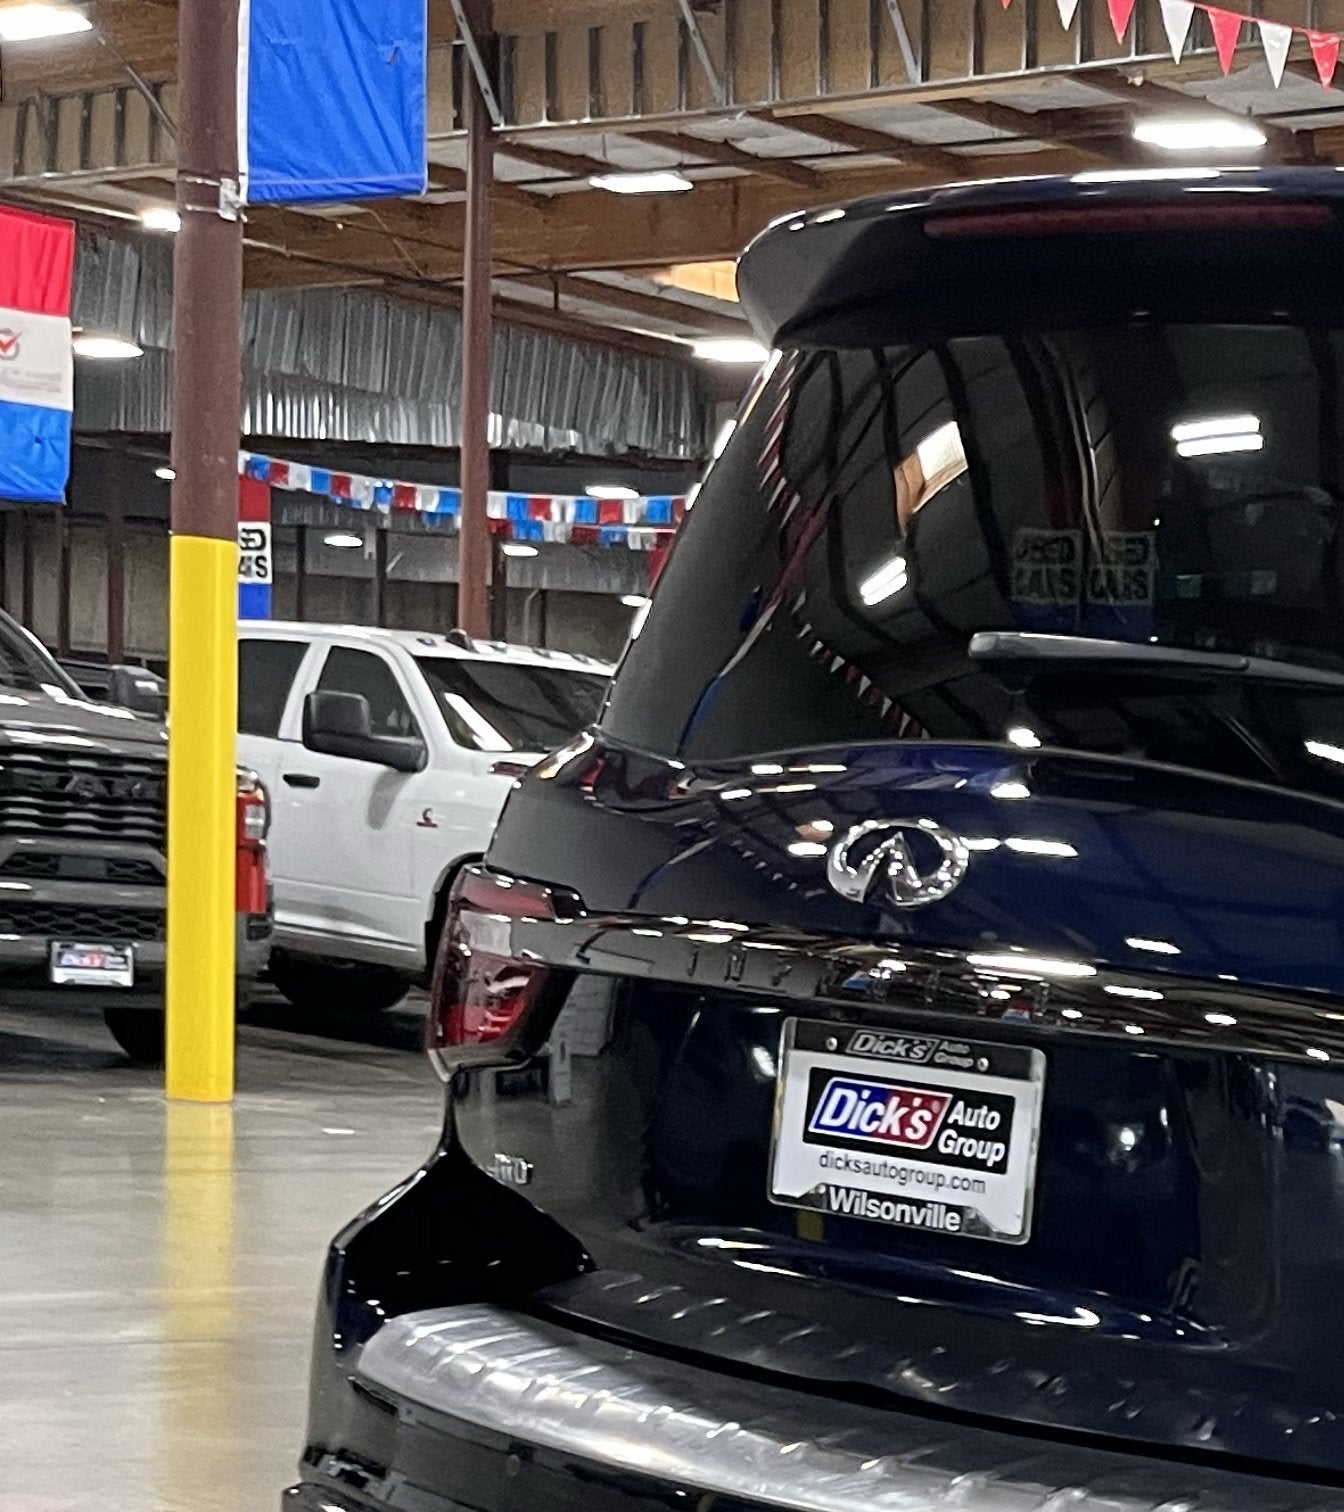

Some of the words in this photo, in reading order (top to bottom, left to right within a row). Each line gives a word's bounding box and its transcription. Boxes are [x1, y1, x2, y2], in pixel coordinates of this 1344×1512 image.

[852, 1033, 928, 1059] Dick's
[819, 1087, 932, 1140] Dick's
[948, 1101, 1000, 1131] Auto
[937, 1129, 1005, 1167] Group
[819, 1151, 987, 1194] dicksautogroup.com
[829, 1185, 961, 1232] Wilsonville
